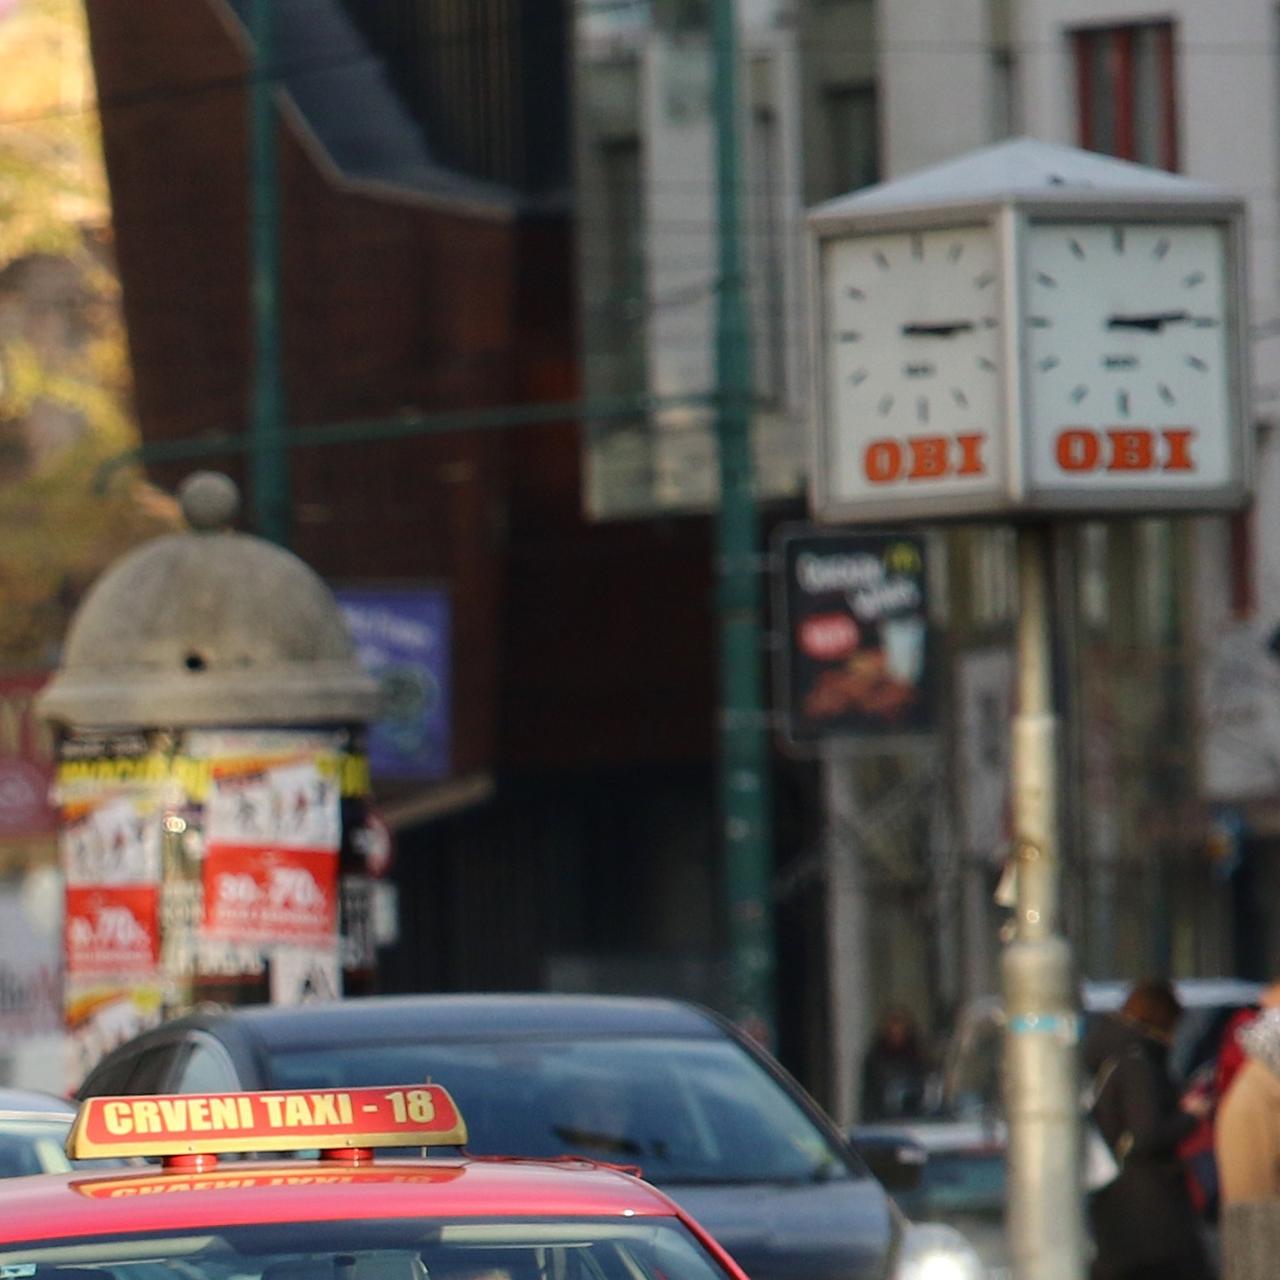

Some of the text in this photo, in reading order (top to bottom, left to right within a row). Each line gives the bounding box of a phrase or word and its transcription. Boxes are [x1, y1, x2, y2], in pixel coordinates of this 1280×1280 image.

[864, 433, 985, 485] OBI
[1055, 429, 1197, 472] OBI
[103, 1097, 253, 1136] CRVENI
[260, 1094, 354, 1128] TAXI
[386, 1090, 436, 1123] 18
